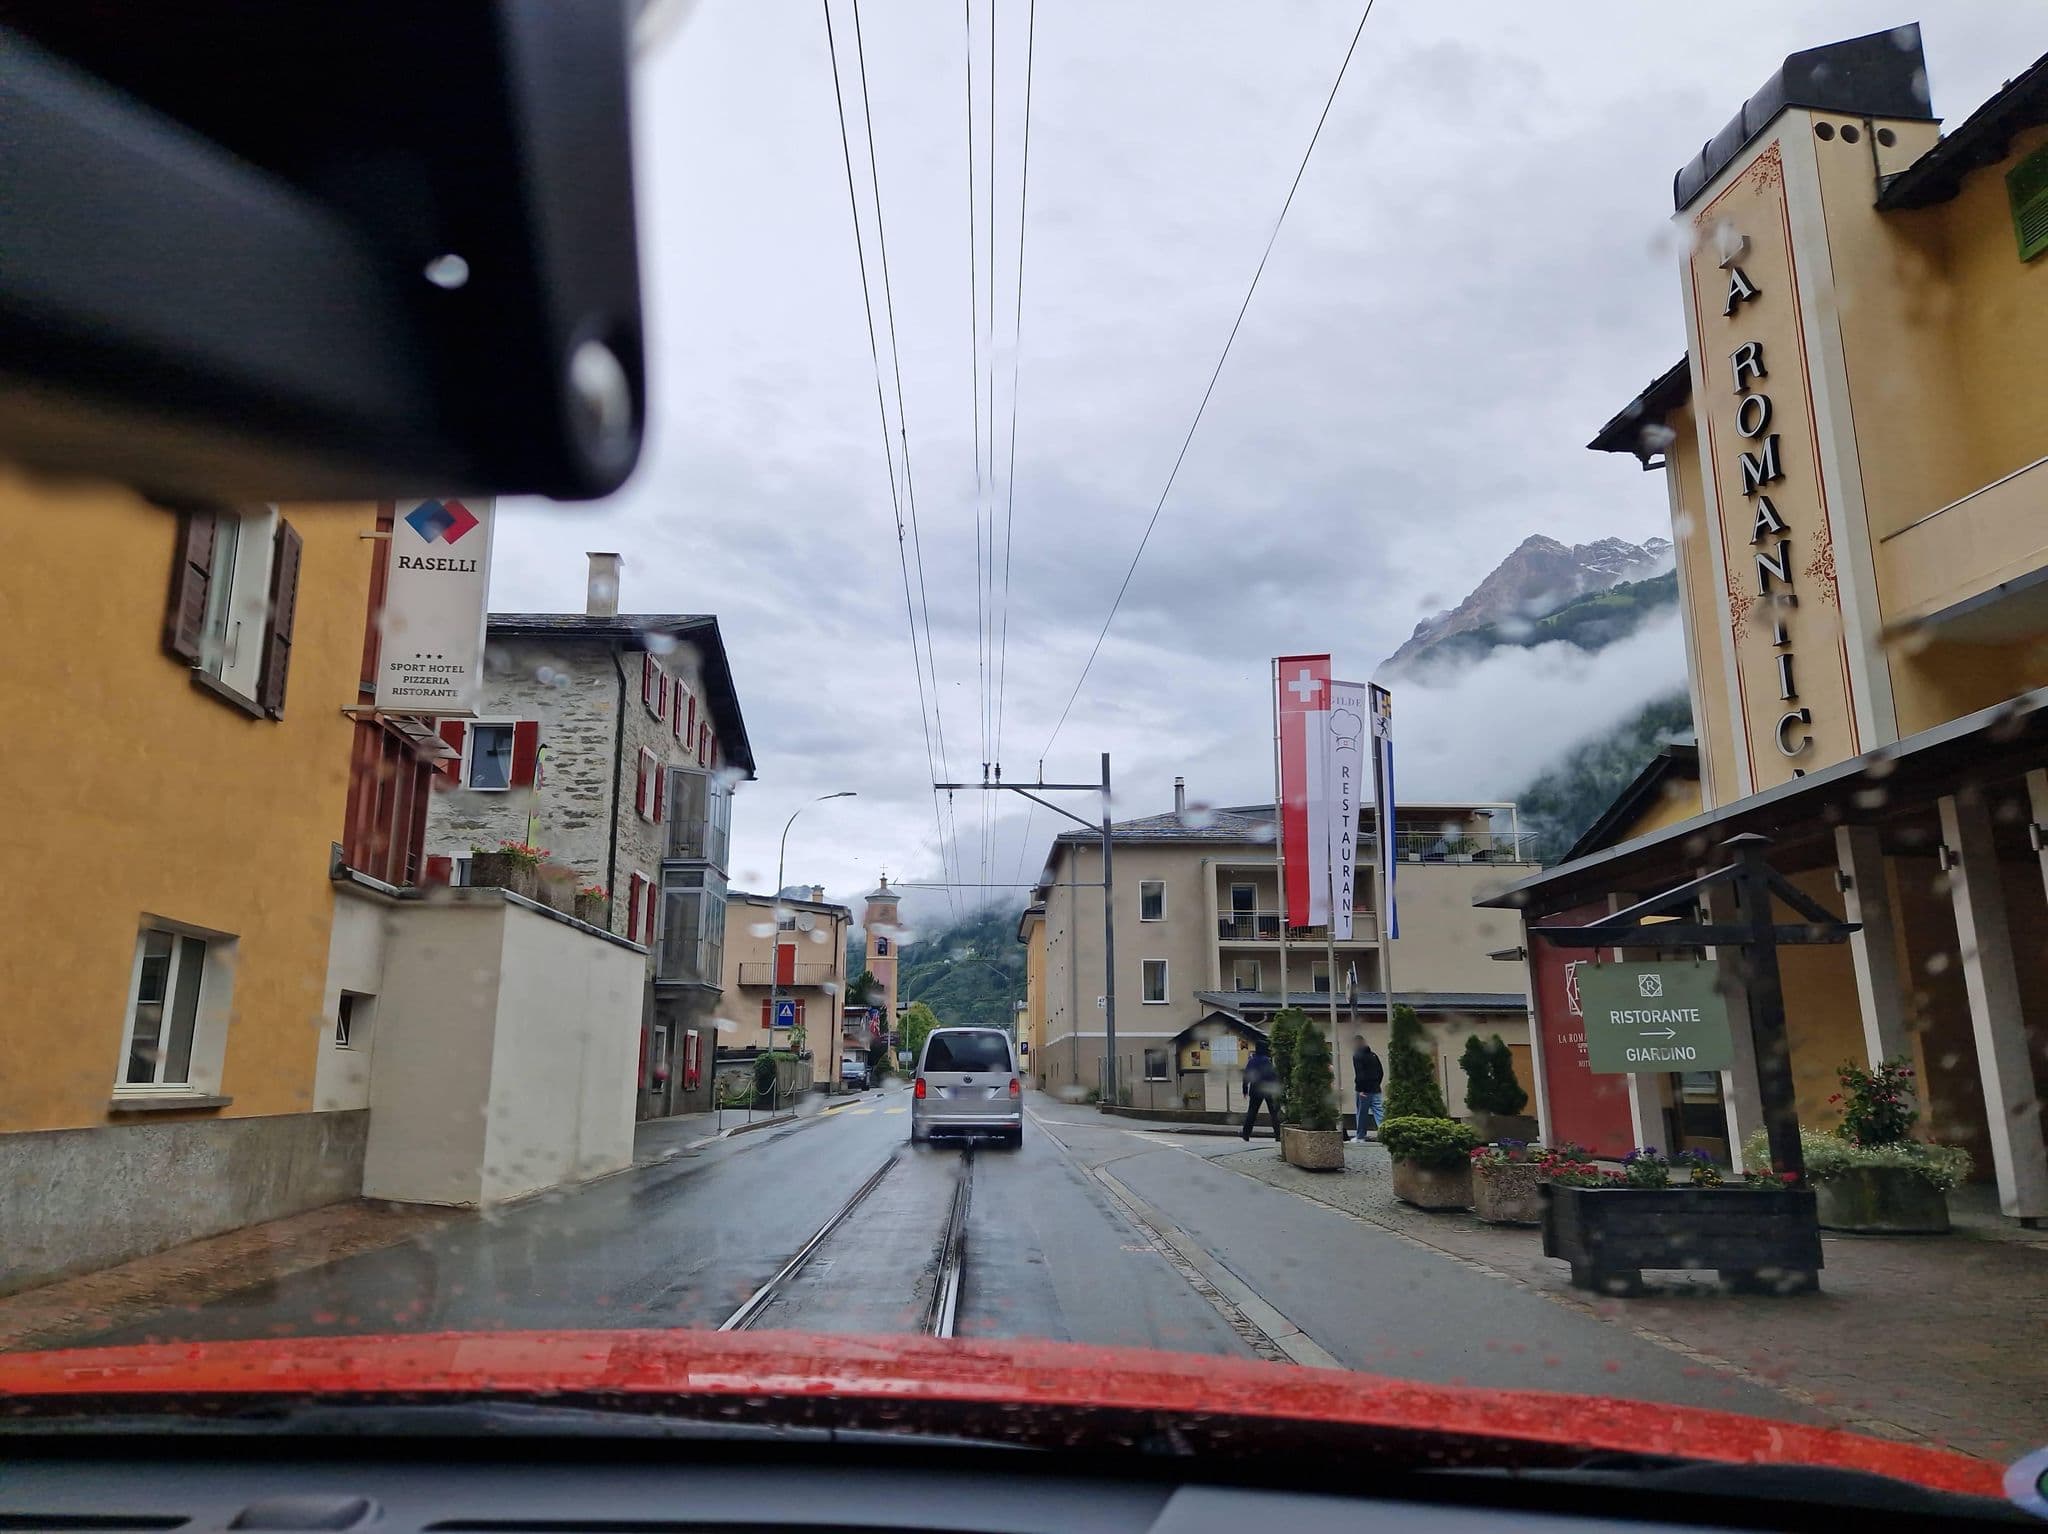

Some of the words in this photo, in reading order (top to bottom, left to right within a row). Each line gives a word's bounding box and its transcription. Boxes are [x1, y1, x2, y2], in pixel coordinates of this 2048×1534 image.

[398, 555, 477, 573] RASELLI
[1728, 340, 1813, 782] ROMANTIC
[390, 662, 426, 672] SPORT
[429, 664, 465, 674] HOTEL
[403, 675, 450, 685] PIZZERIA
[1341, 765, 1351, 929] RESTAURANT
[1610, 1008, 1701, 1024] RISTORANTE
[1626, 1046, 1696, 1062] GIARDINO
